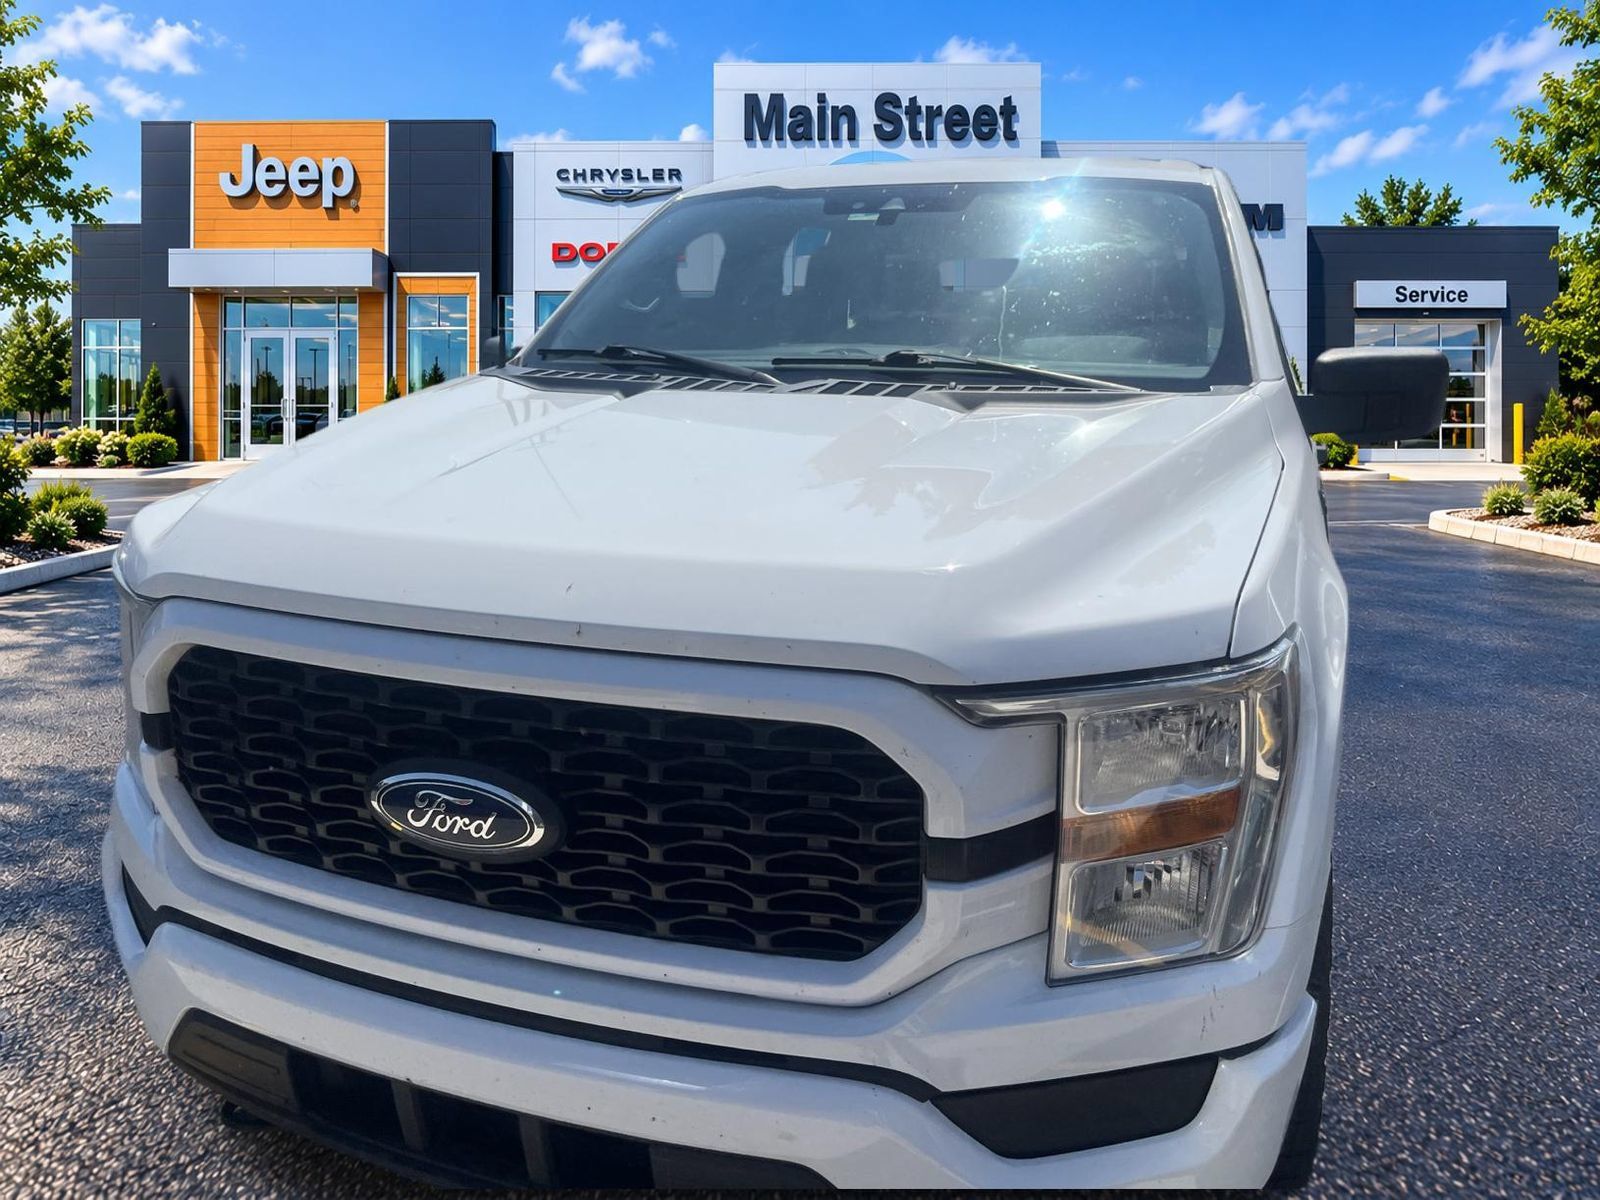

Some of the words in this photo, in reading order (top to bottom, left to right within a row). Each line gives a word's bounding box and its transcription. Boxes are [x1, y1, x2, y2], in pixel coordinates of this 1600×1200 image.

[744, 92, 857, 142] Main
[873, 91, 1018, 142] Street
[218, 143, 355, 208] Jeep
[556, 168, 683, 182] CHRYSLER
[551, 242, 621, 262] DO
[1395, 285, 1469, 303] Service
[406, 789, 498, 840] Ford
